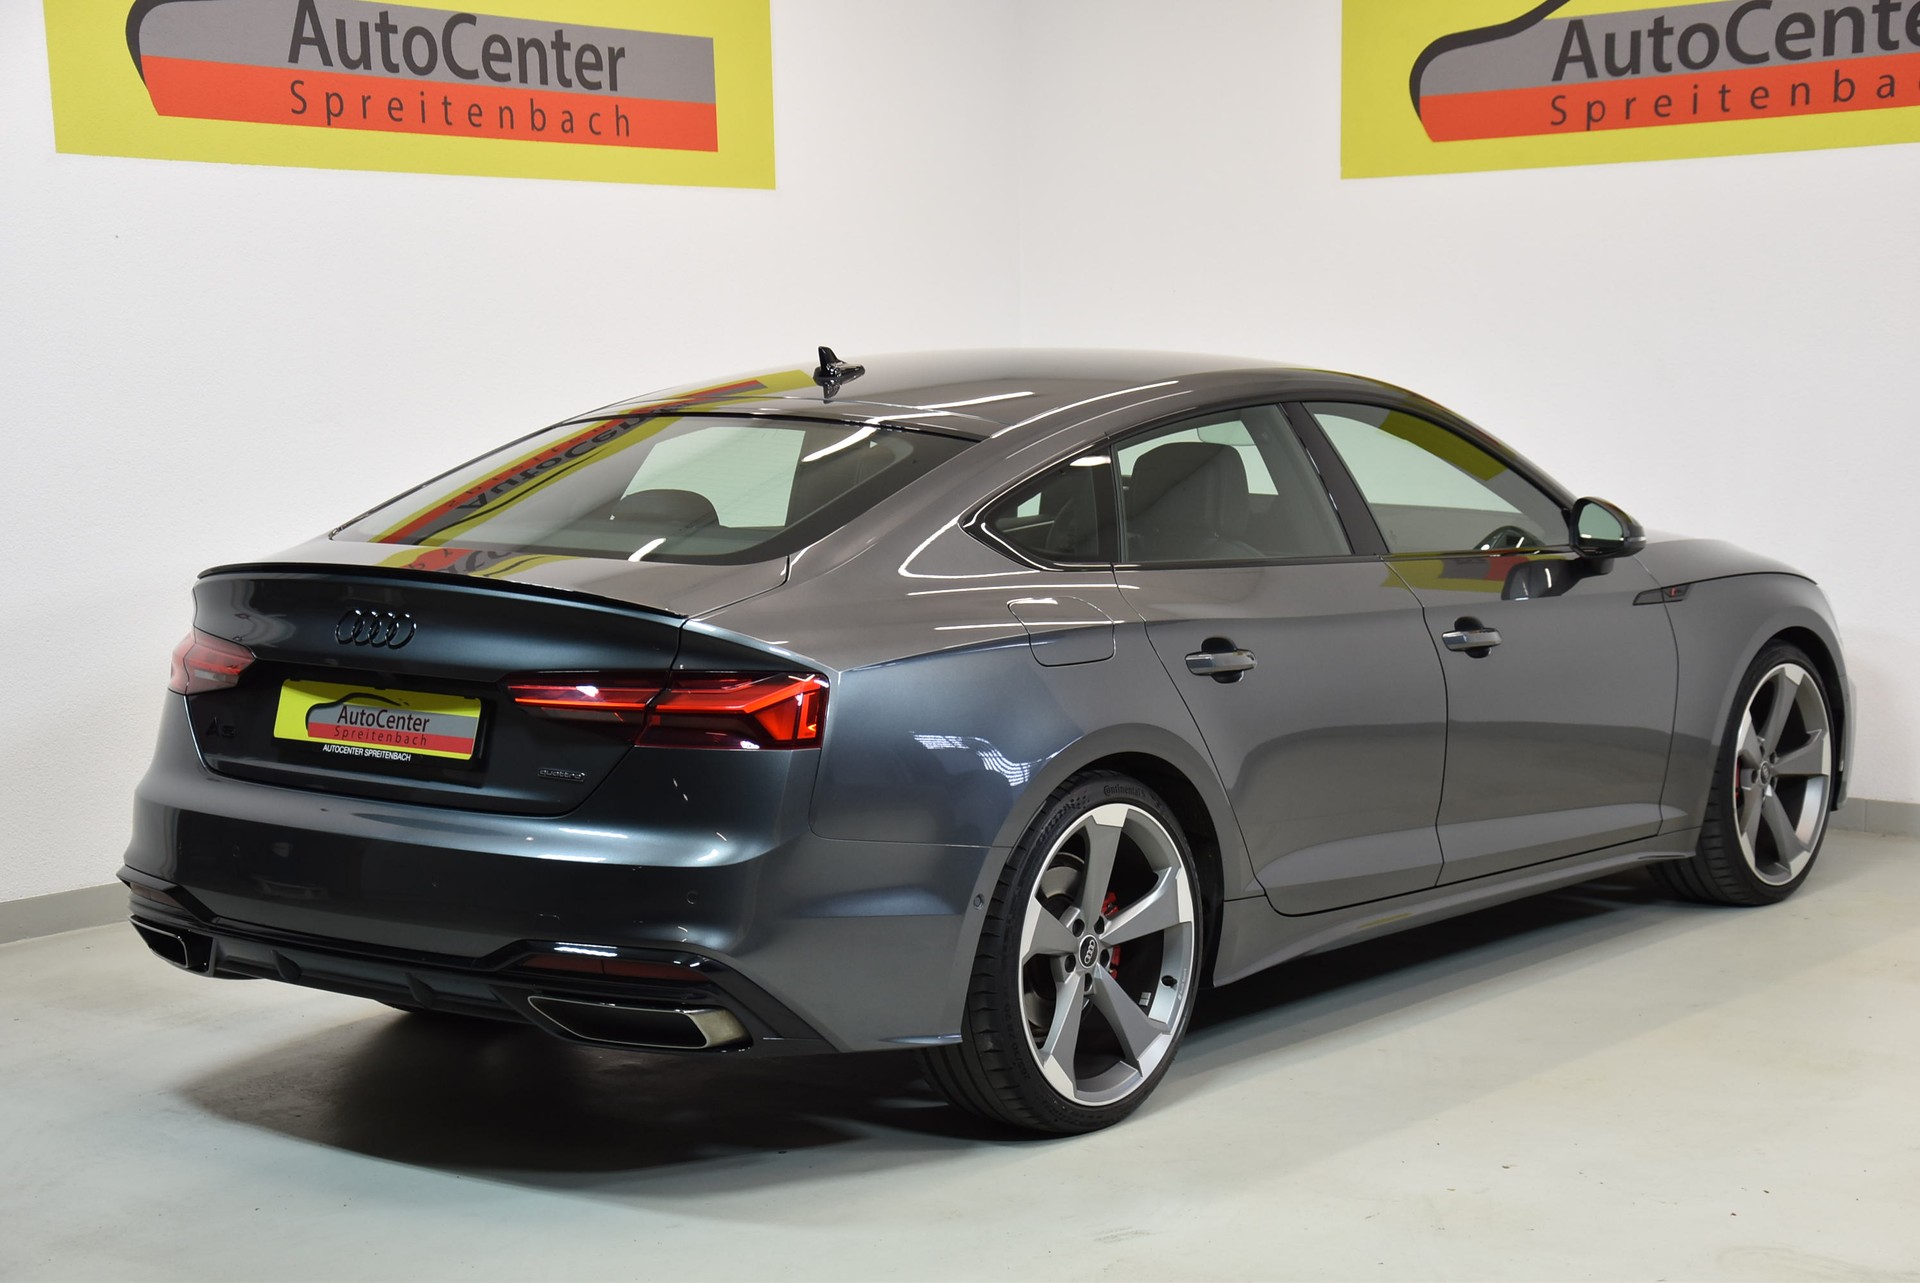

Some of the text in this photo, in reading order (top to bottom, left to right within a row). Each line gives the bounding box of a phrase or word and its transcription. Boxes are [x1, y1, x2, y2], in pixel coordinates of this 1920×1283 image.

[288, 0, 626, 92] AutoCenter
[290, 79, 630, 137] Spreitenbach
[1551, 68, 1920, 131] Spreitenba
[337, 705, 430, 733] AutoCenter
[334, 725, 427, 746] Spreitenbach
[322, 744, 412, 761] AUTOCENTER SPREITENBACH
[538, 768, 585, 781] quattro
